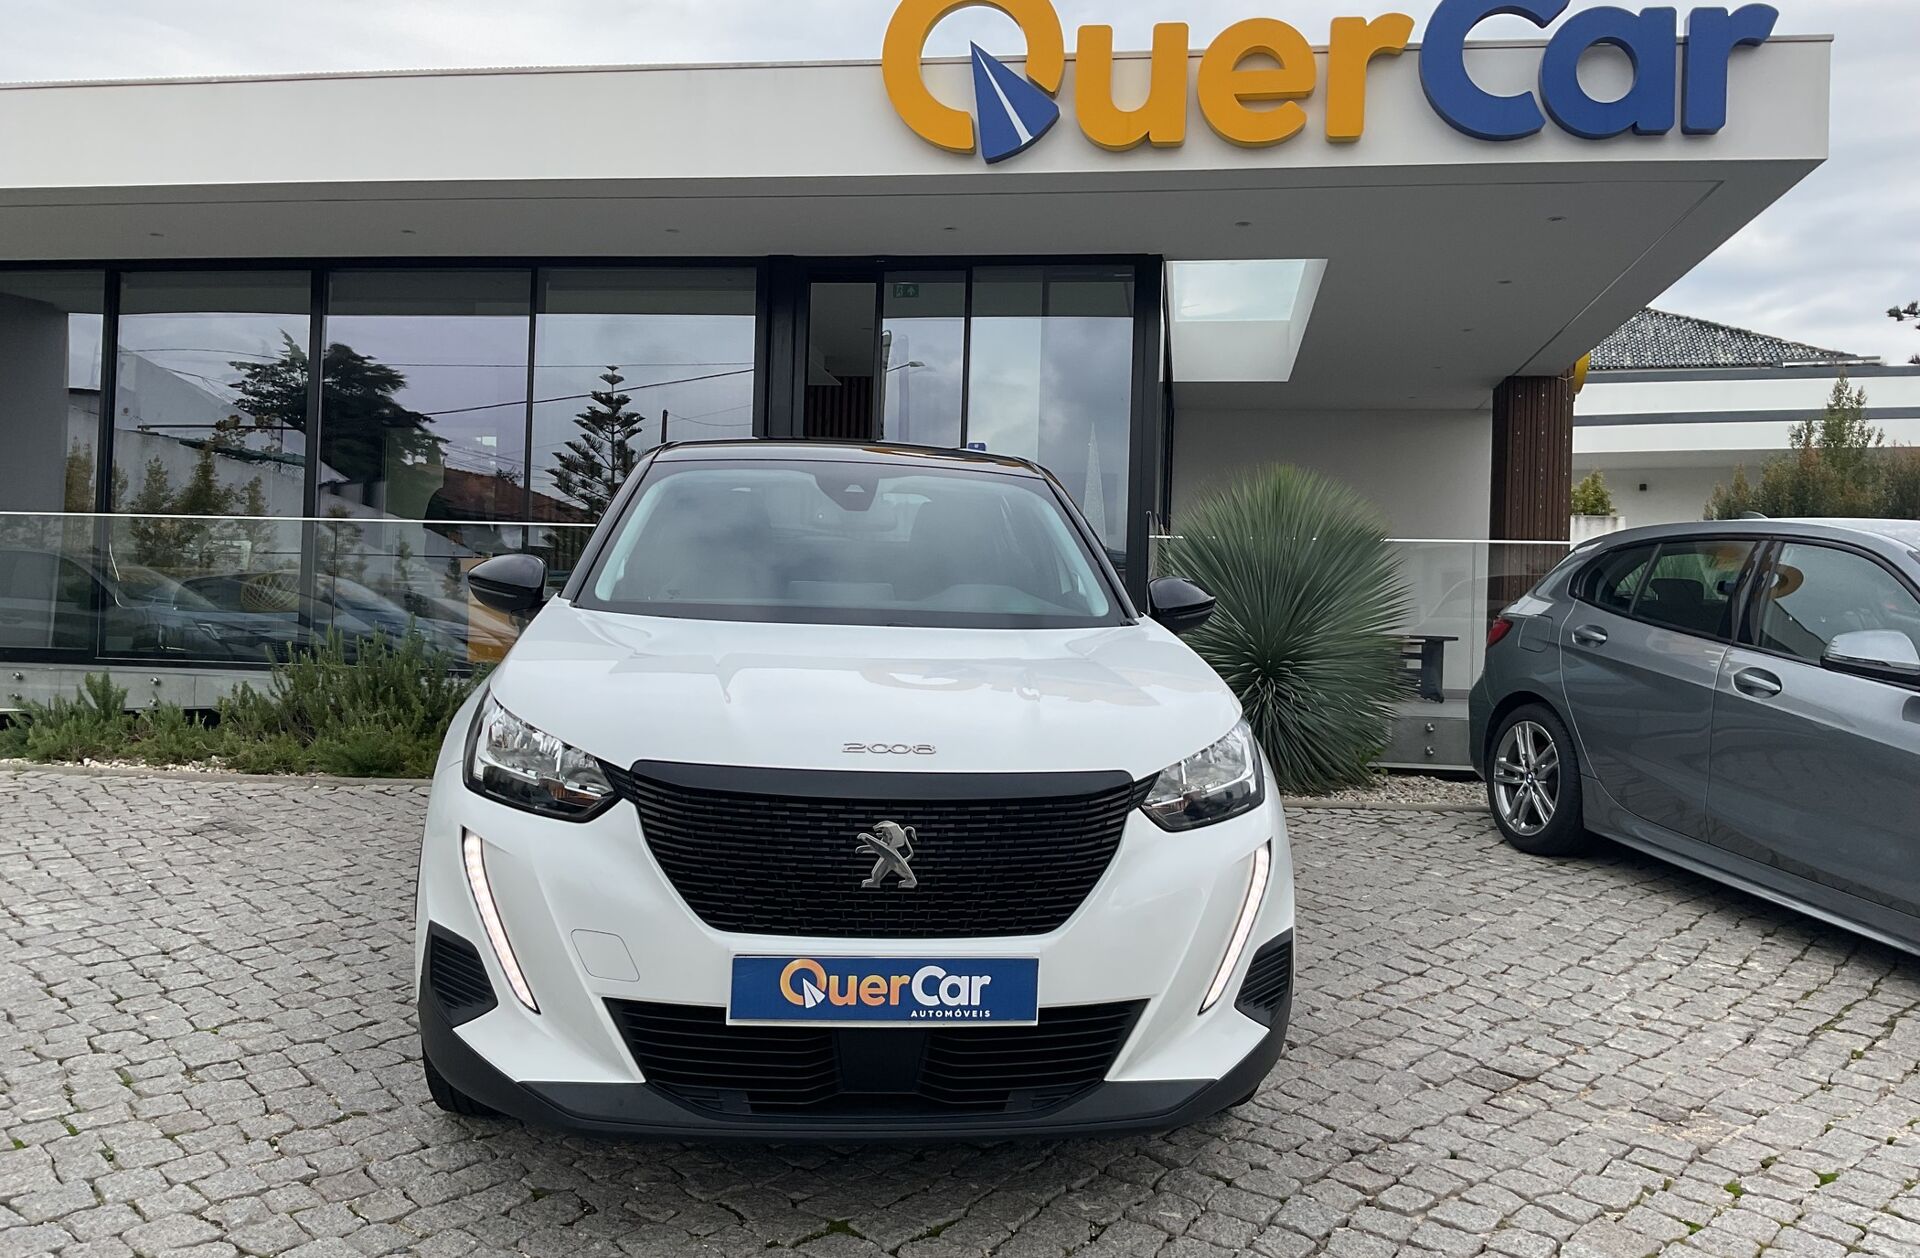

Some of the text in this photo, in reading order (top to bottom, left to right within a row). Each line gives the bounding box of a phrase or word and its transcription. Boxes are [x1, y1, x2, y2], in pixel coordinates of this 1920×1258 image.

[882, 0, 1779, 164] QuerCar
[842, 743, 936, 755] 2008
[779, 958, 992, 1008] QuerCar
[910, 1008, 991, 1018] AUTOMÓVEIS
